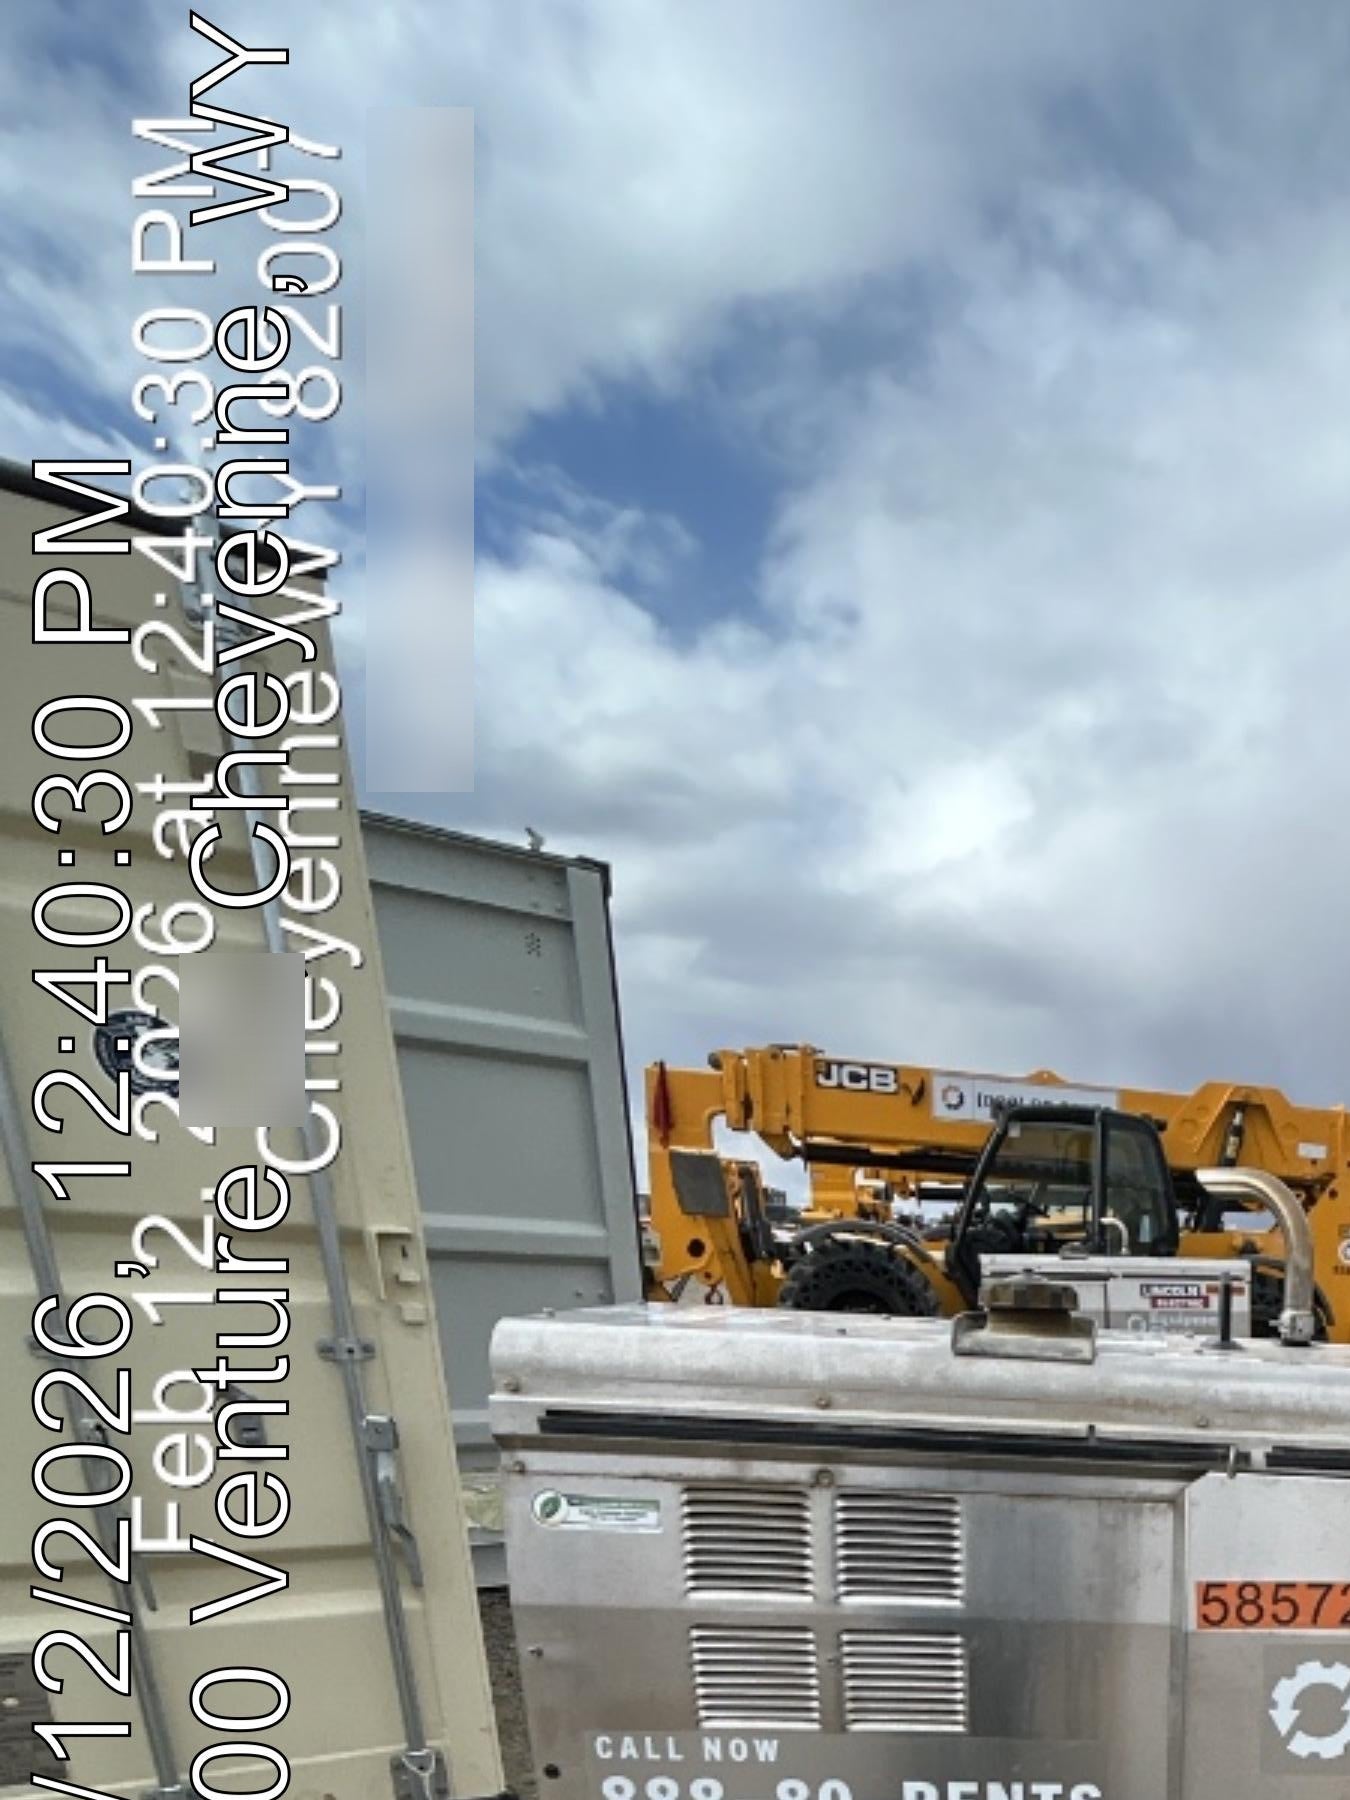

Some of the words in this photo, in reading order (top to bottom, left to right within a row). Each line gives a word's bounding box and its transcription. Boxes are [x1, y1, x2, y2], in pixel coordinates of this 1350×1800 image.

[816, 1062, 898, 1094] JCB
[595, 1735, 685, 1762] CALL
[703, 1737, 779, 1763] NOW
